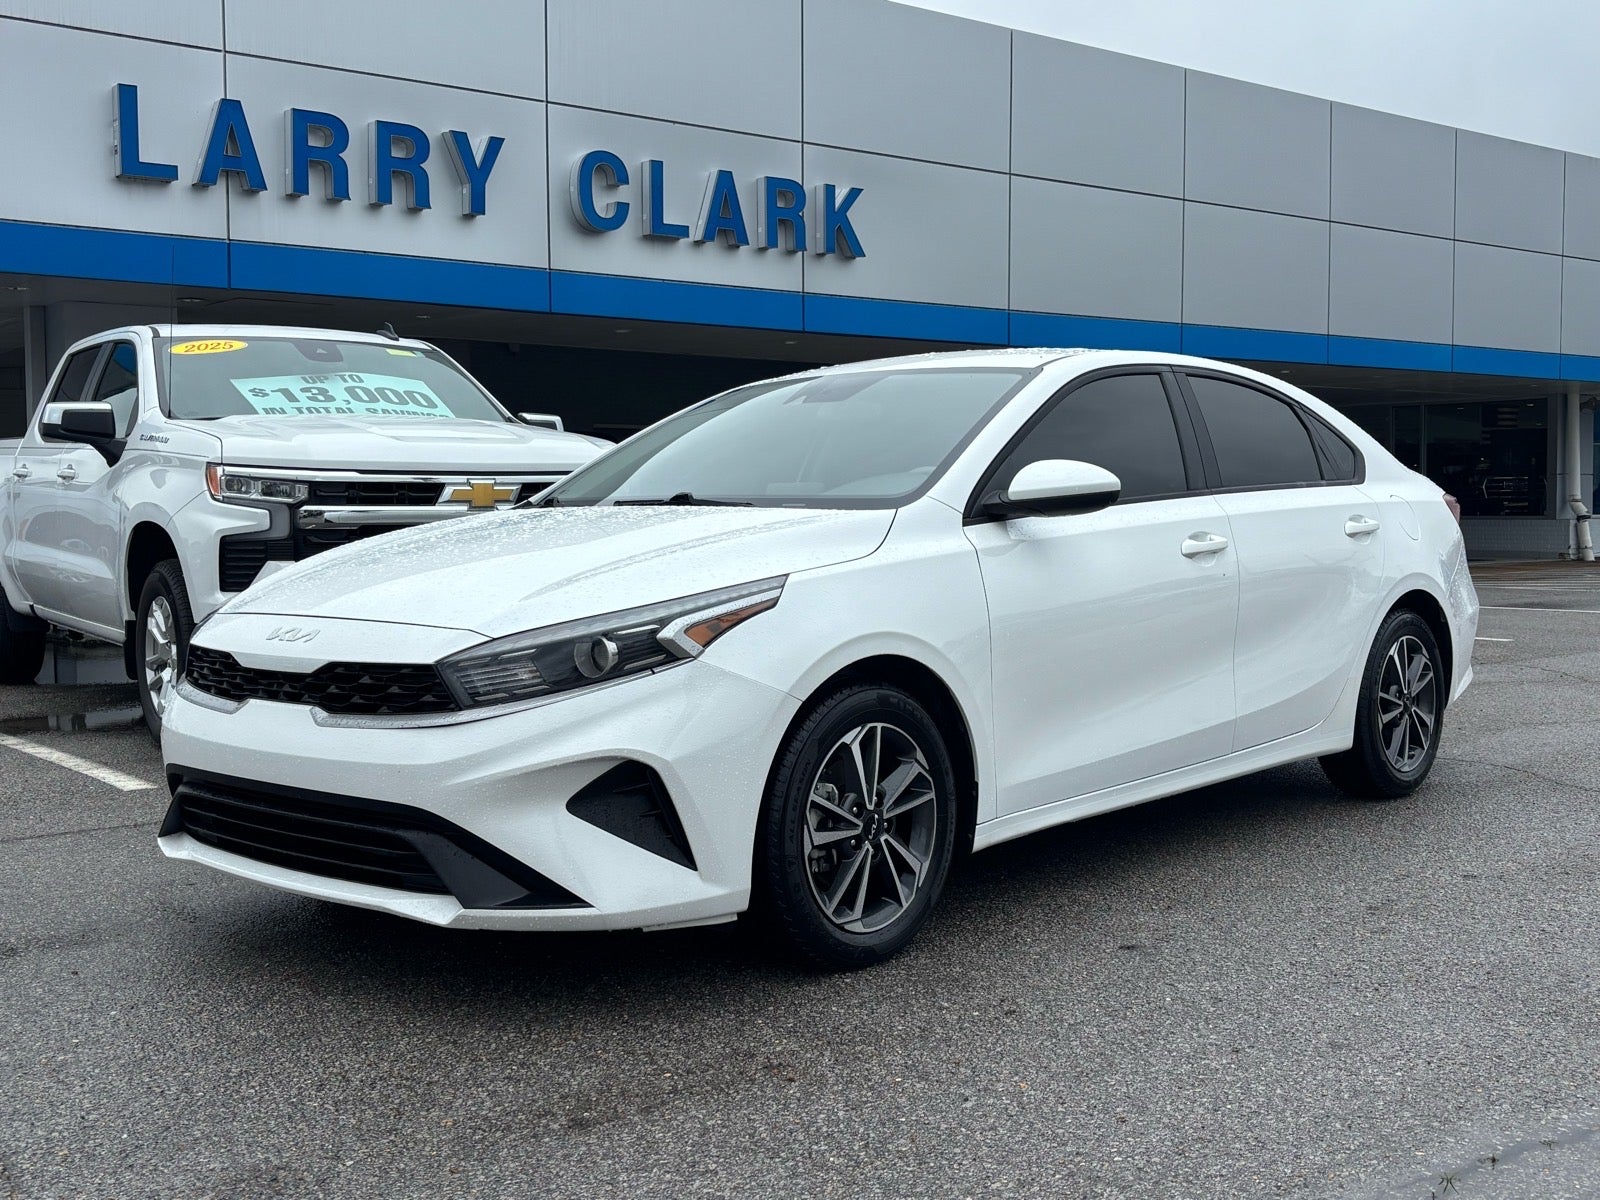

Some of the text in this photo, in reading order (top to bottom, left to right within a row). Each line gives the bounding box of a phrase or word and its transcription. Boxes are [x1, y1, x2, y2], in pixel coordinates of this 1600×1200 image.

[112, 83, 866, 258] LARRY CLARK
[184, 342, 234, 353] 2025
[300, 374, 365, 385] UP TO
[248, 386, 439, 409] $13,000
[261, 407, 288, 415] IN
